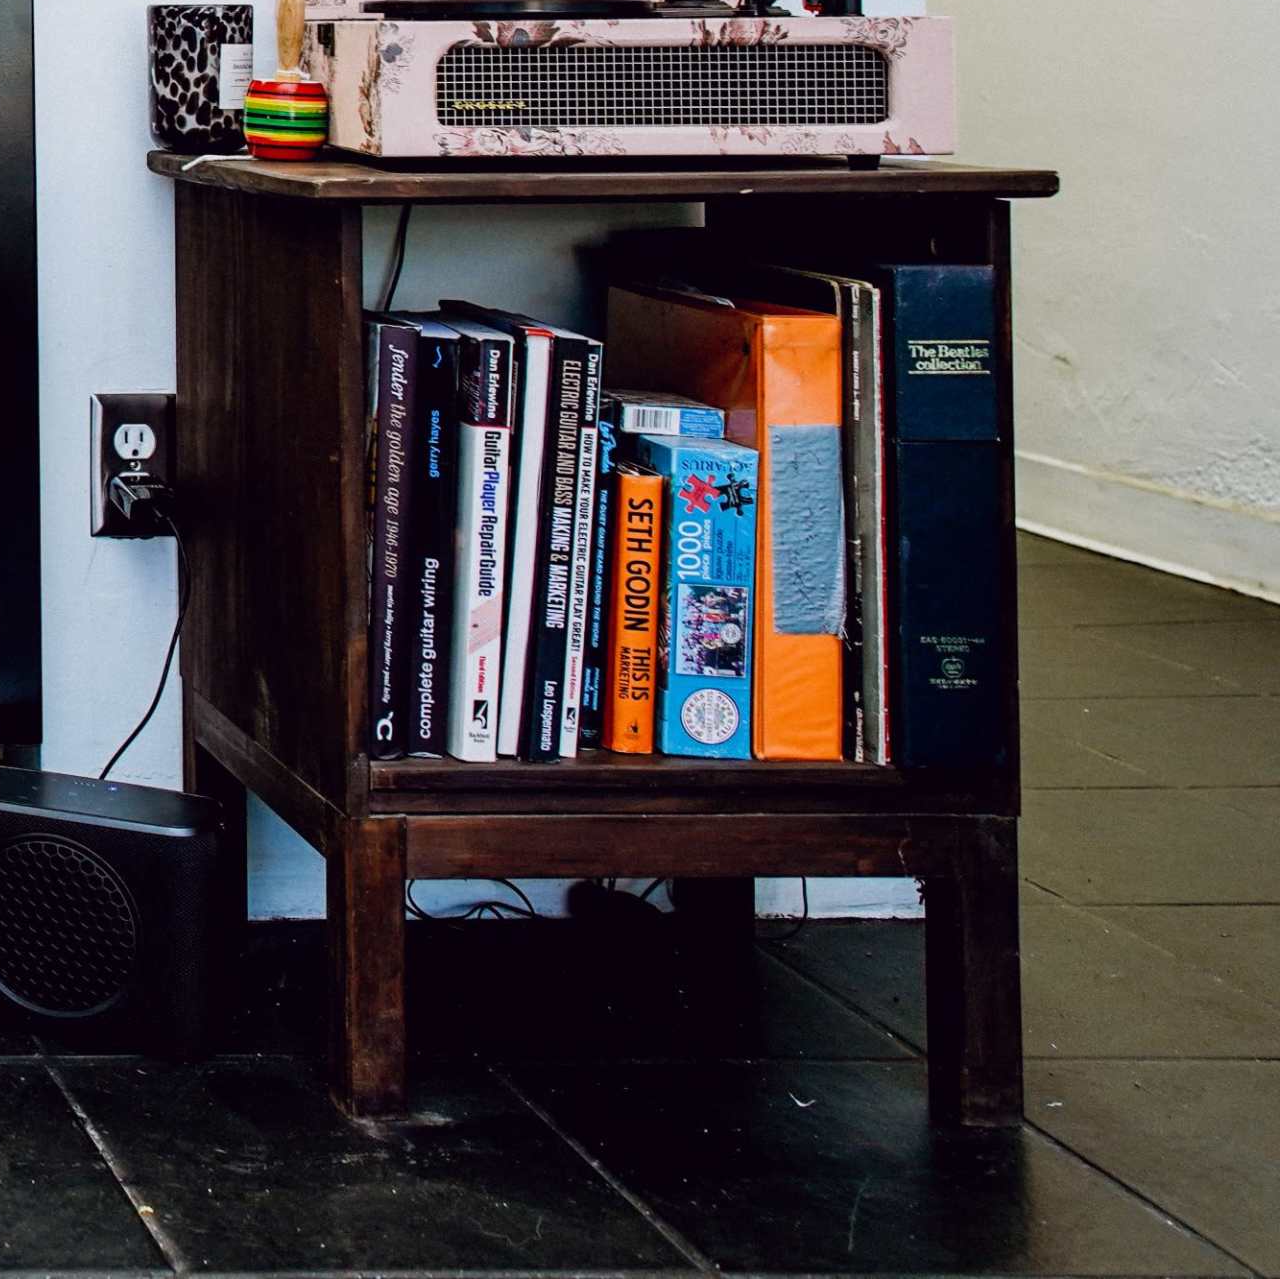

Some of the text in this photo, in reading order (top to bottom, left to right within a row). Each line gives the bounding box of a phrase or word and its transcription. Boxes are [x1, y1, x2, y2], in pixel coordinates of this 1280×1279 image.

[389, 344, 409, 400] fender
[908, 345, 990, 359] The Beatles
[915, 359, 982, 371] collection
[487, 349, 501, 419] Dan Erlewine
[560, 360, 582, 411] ELECTRIC
[585, 353, 599, 421] Dan Erlewine
[390, 405, 407, 428] the
[557, 411, 578, 450] GUITAR
[386, 430, 405, 484] golden
[428, 447, 440, 478] gerry
[555, 453, 576, 475] AND
[383, 486, 400, 516] age
[553, 476, 574, 506] BASS
[549, 507, 572, 553] MAKING
[570, 433, 594, 652] HOW TO MAKE YOUR ELECTRIC GUITAR PLAY GREAT!
[677, 521, 703, 581] 1000
[478, 558, 496, 597] Guide
[550, 553, 568, 562] &
[624, 497, 654, 632] SETH GODIN
[545, 563, 568, 629] MARKETING
[417, 557, 440, 739] complete guitar wiring
[542, 680, 558, 698] Leo
[618, 646, 631, 700] MARKETING
[631, 647, 651, 701] THIS IS
